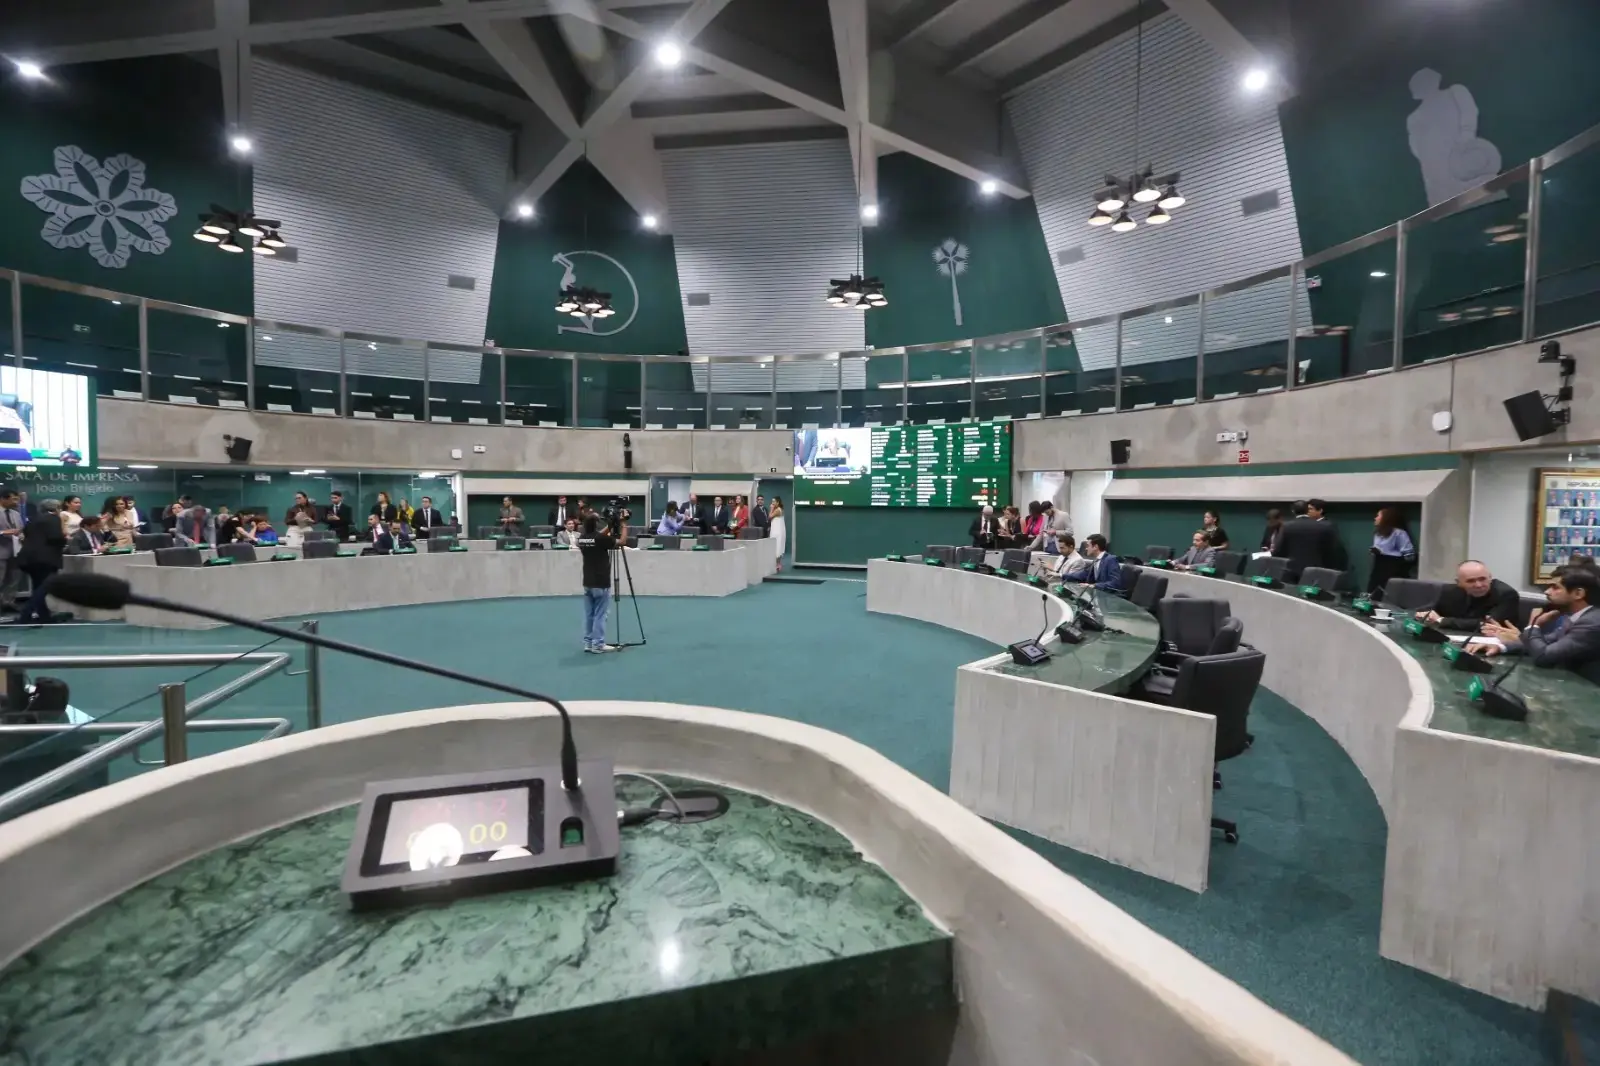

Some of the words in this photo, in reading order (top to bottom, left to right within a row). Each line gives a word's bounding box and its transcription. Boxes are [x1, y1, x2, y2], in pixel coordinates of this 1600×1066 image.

[6, 471, 42, 480] SALA
[50, 472, 69, 481] DE
[74, 472, 140, 482] IMPRENSA
